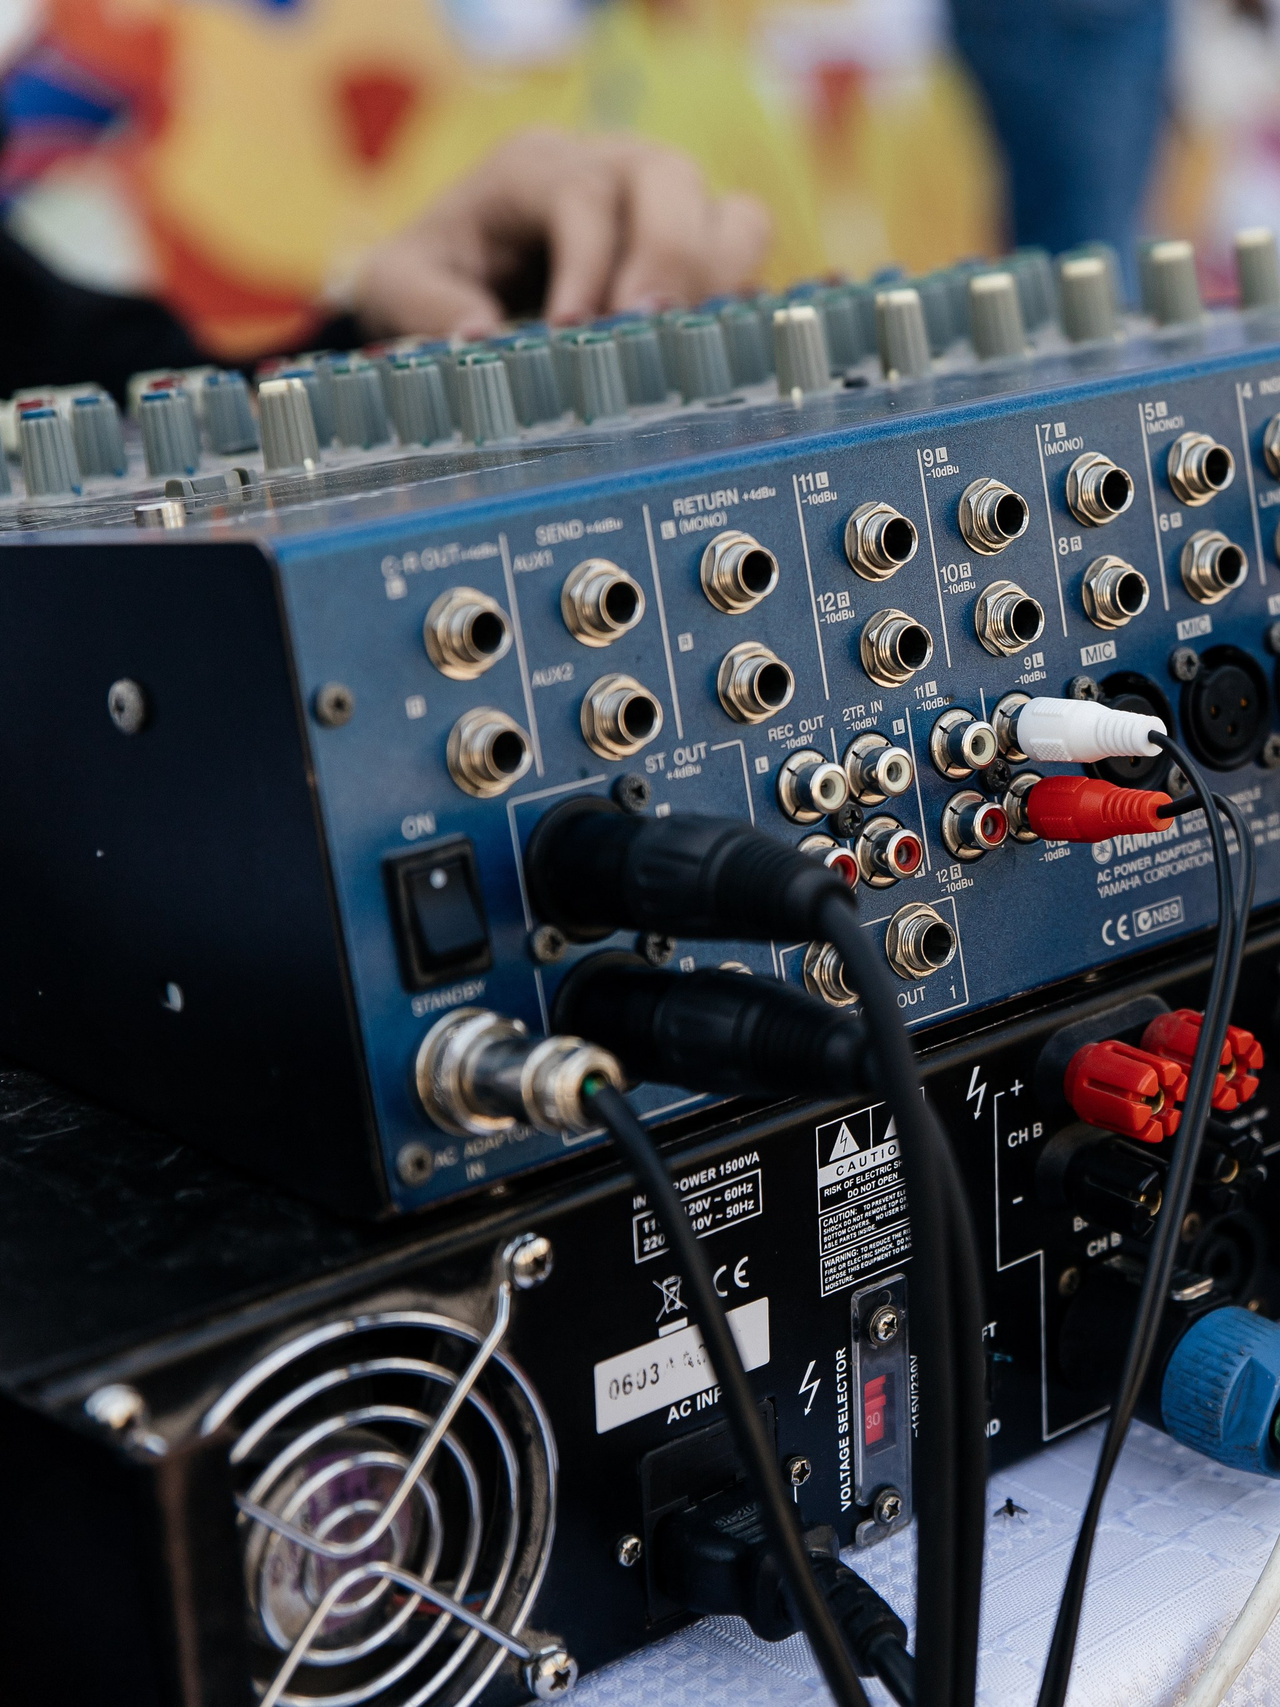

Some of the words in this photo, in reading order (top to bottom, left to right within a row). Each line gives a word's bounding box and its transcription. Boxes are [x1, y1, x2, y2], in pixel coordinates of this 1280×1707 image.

[1145, 403, 1155, 421] 5
[1041, 424, 1052, 442] 7
[1044, 436, 1084, 457] (MONO)
[923, 450, 934, 467] 9
[926, 464, 959, 479] -10dBu
[799, 474, 815, 493] 11
[673, 488, 739, 516] RETURN
[802, 491, 837, 506] -10dBu
[535, 519, 584, 546] SEND
[679, 511, 728, 535] (MONO)
[1159, 514, 1170, 532] 6
[1058, 537, 1069, 555] 8
[940, 564, 958, 583] 10
[943, 580, 976, 595] -10dBu
[817, 593, 835, 613] 12
[820, 610, 855, 625] -10dBu
[1179, 615, 1210, 639] MIC
[1024, 656, 1032, 670] 9
[1083, 642, 1115, 665] MIC
[532, 662, 575, 688] AUX2
[1015, 670, 1046, 685] -10dBu
[914, 685, 925, 699] 11
[842, 704, 867, 721] 2TR
[870, 700, 883, 714] IN
[916, 697, 949, 711] -10dBu
[768, 724, 793, 741] REC
[799, 715, 824, 736] OUT
[846, 716, 877, 732] -10dBV
[781, 734, 813, 749] -10dBV
[645, 751, 667, 774] ST
[674, 741, 707, 766] OUT
[402, 810, 436, 840] ON
[1113, 820, 1180, 856] YAMAHA
[1039, 847, 1070, 862] -10dBu
[936, 869, 948, 884] 12
[1097, 869, 1112, 884] AC
[1114, 856, 1152, 878] POWER
[1097, 875, 1142, 898] YAMAHA
[1143, 851, 1213, 884] CORPORATION
[941, 877, 974, 893] -10dBu
[1152, 903, 1179, 926] N89
[411, 979, 487, 1018] STANDBY
[897, 986, 926, 1008] OUT
[1008, 1127, 1029, 1148] CH
[1033, 1122, 1043, 1138] B
[720, 1151, 760, 1176] 1500VA
[836, 1144, 897, 1176] CAUTIO
[824, 1184, 842, 1197] RISK
[844, 1179, 854, 1189] OF
[856, 1163, 892, 1184] ELECTRIC
[847, 1188, 859, 1199] DO
[860, 1180, 876, 1194] NOT
[877, 1172, 898, 1186] OPEN
[724, 1183, 753, 1201] 60Hz
[726, 1200, 755, 1218] 50Hz
[823, 1208, 858, 1227] CAUTION:
[871, 1193, 896, 1207] PREVENT
[823, 1223, 842, 1235] SHOCK
[843, 1219, 851, 1227] DO
[852, 1214, 863, 1223] NOT
[864, 1204, 887, 1218] REMOVE
[823, 1230, 846, 1243] BOTTOM
[875, 1213, 884, 1221] NO
[823, 1240, 838, 1250] ABLE
[840, 1232, 857, 1243] PARTS
[823, 1249, 859, 1269] WARNING:
[869, 1236, 891, 1250] REDUCE
[824, 1267, 837, 1276] FIRE
[838, 1262, 846, 1270] OR
[847, 1253, 873, 1267] ELECTRIC
[824, 1270, 847, 1284] EXPOSE
[848, 1264, 860, 1273] THIS
[892, 1247, 900, 1255] TO
[835, 1347, 849, 1436] SELECTOR
[667, 1400, 692, 1424] AC
[838, 1440, 850, 1512] VOLTAGE
